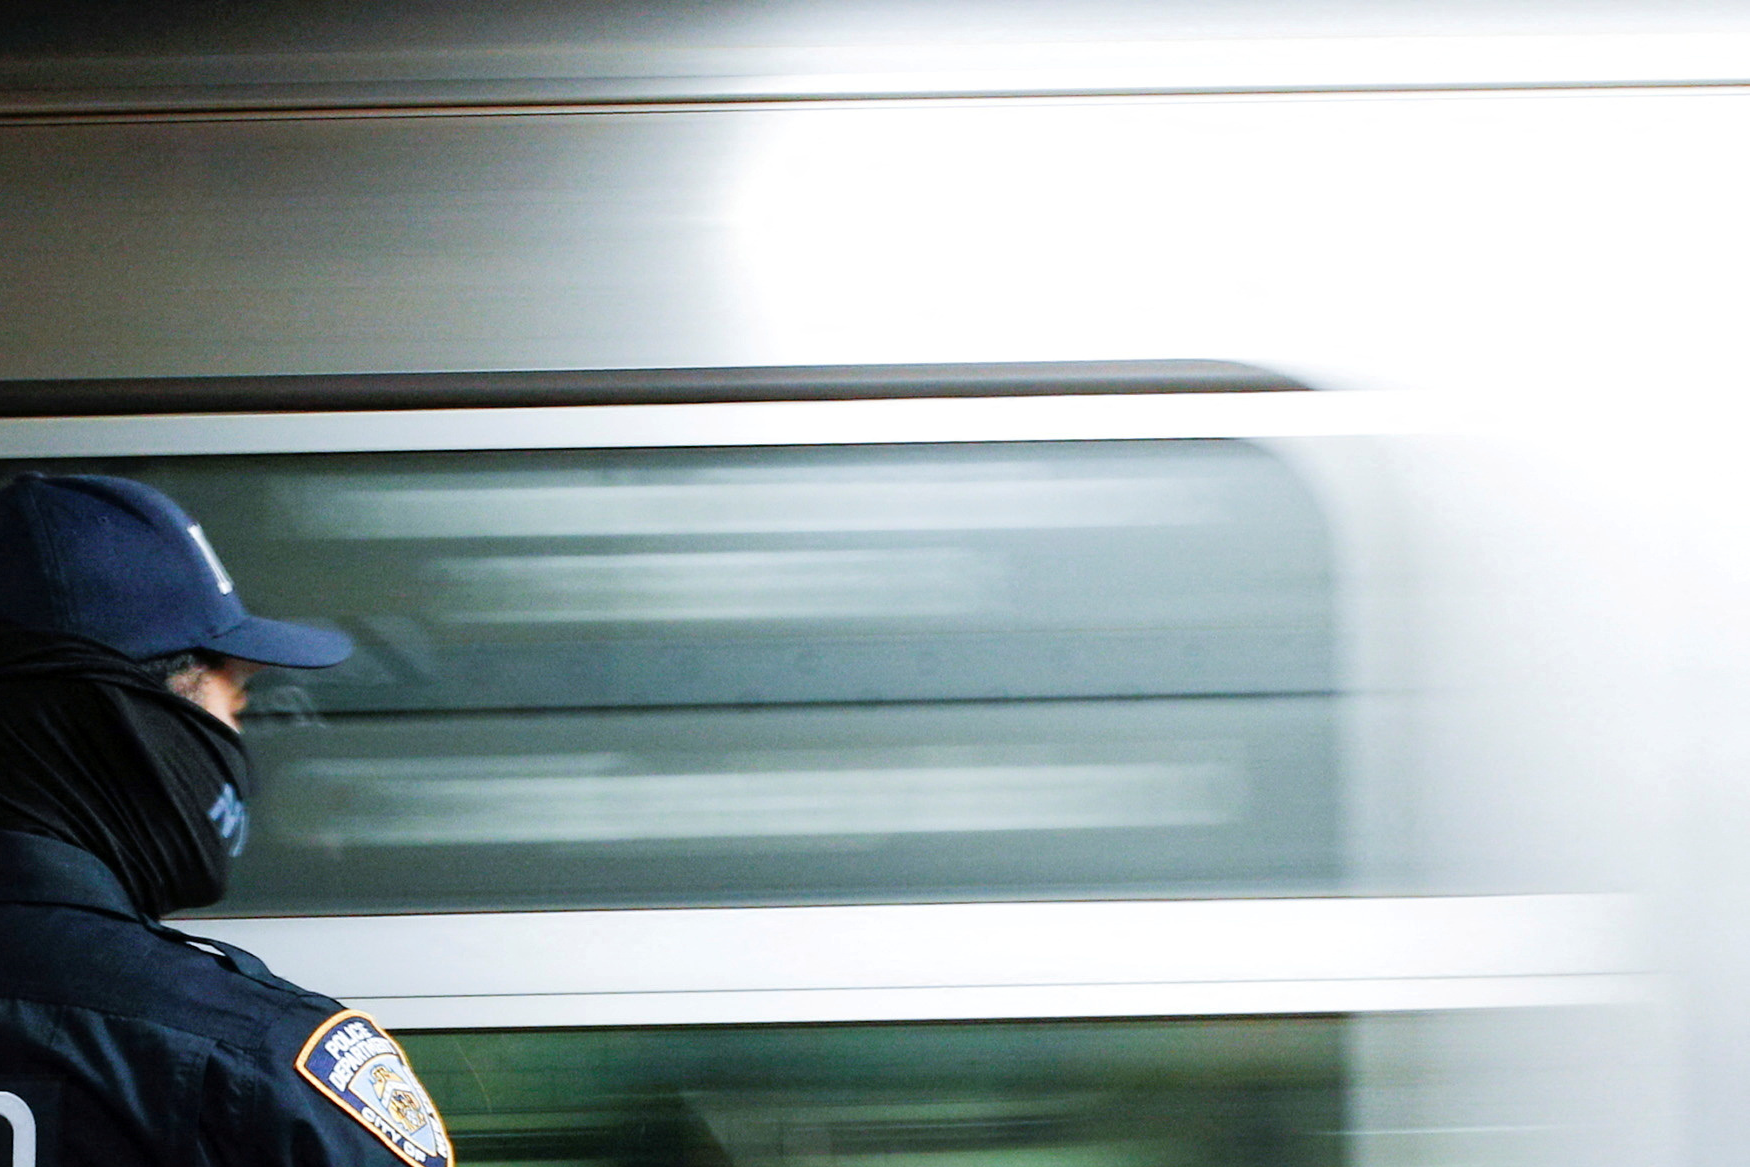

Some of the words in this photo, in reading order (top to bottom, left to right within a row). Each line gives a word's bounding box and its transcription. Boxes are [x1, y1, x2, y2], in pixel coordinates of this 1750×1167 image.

[325, 1021, 373, 1060] POLICE
[328, 1037, 398, 1092] DEPARTMENT
[361, 1107, 401, 1143] CITY
[403, 1143, 427, 1163] OF
